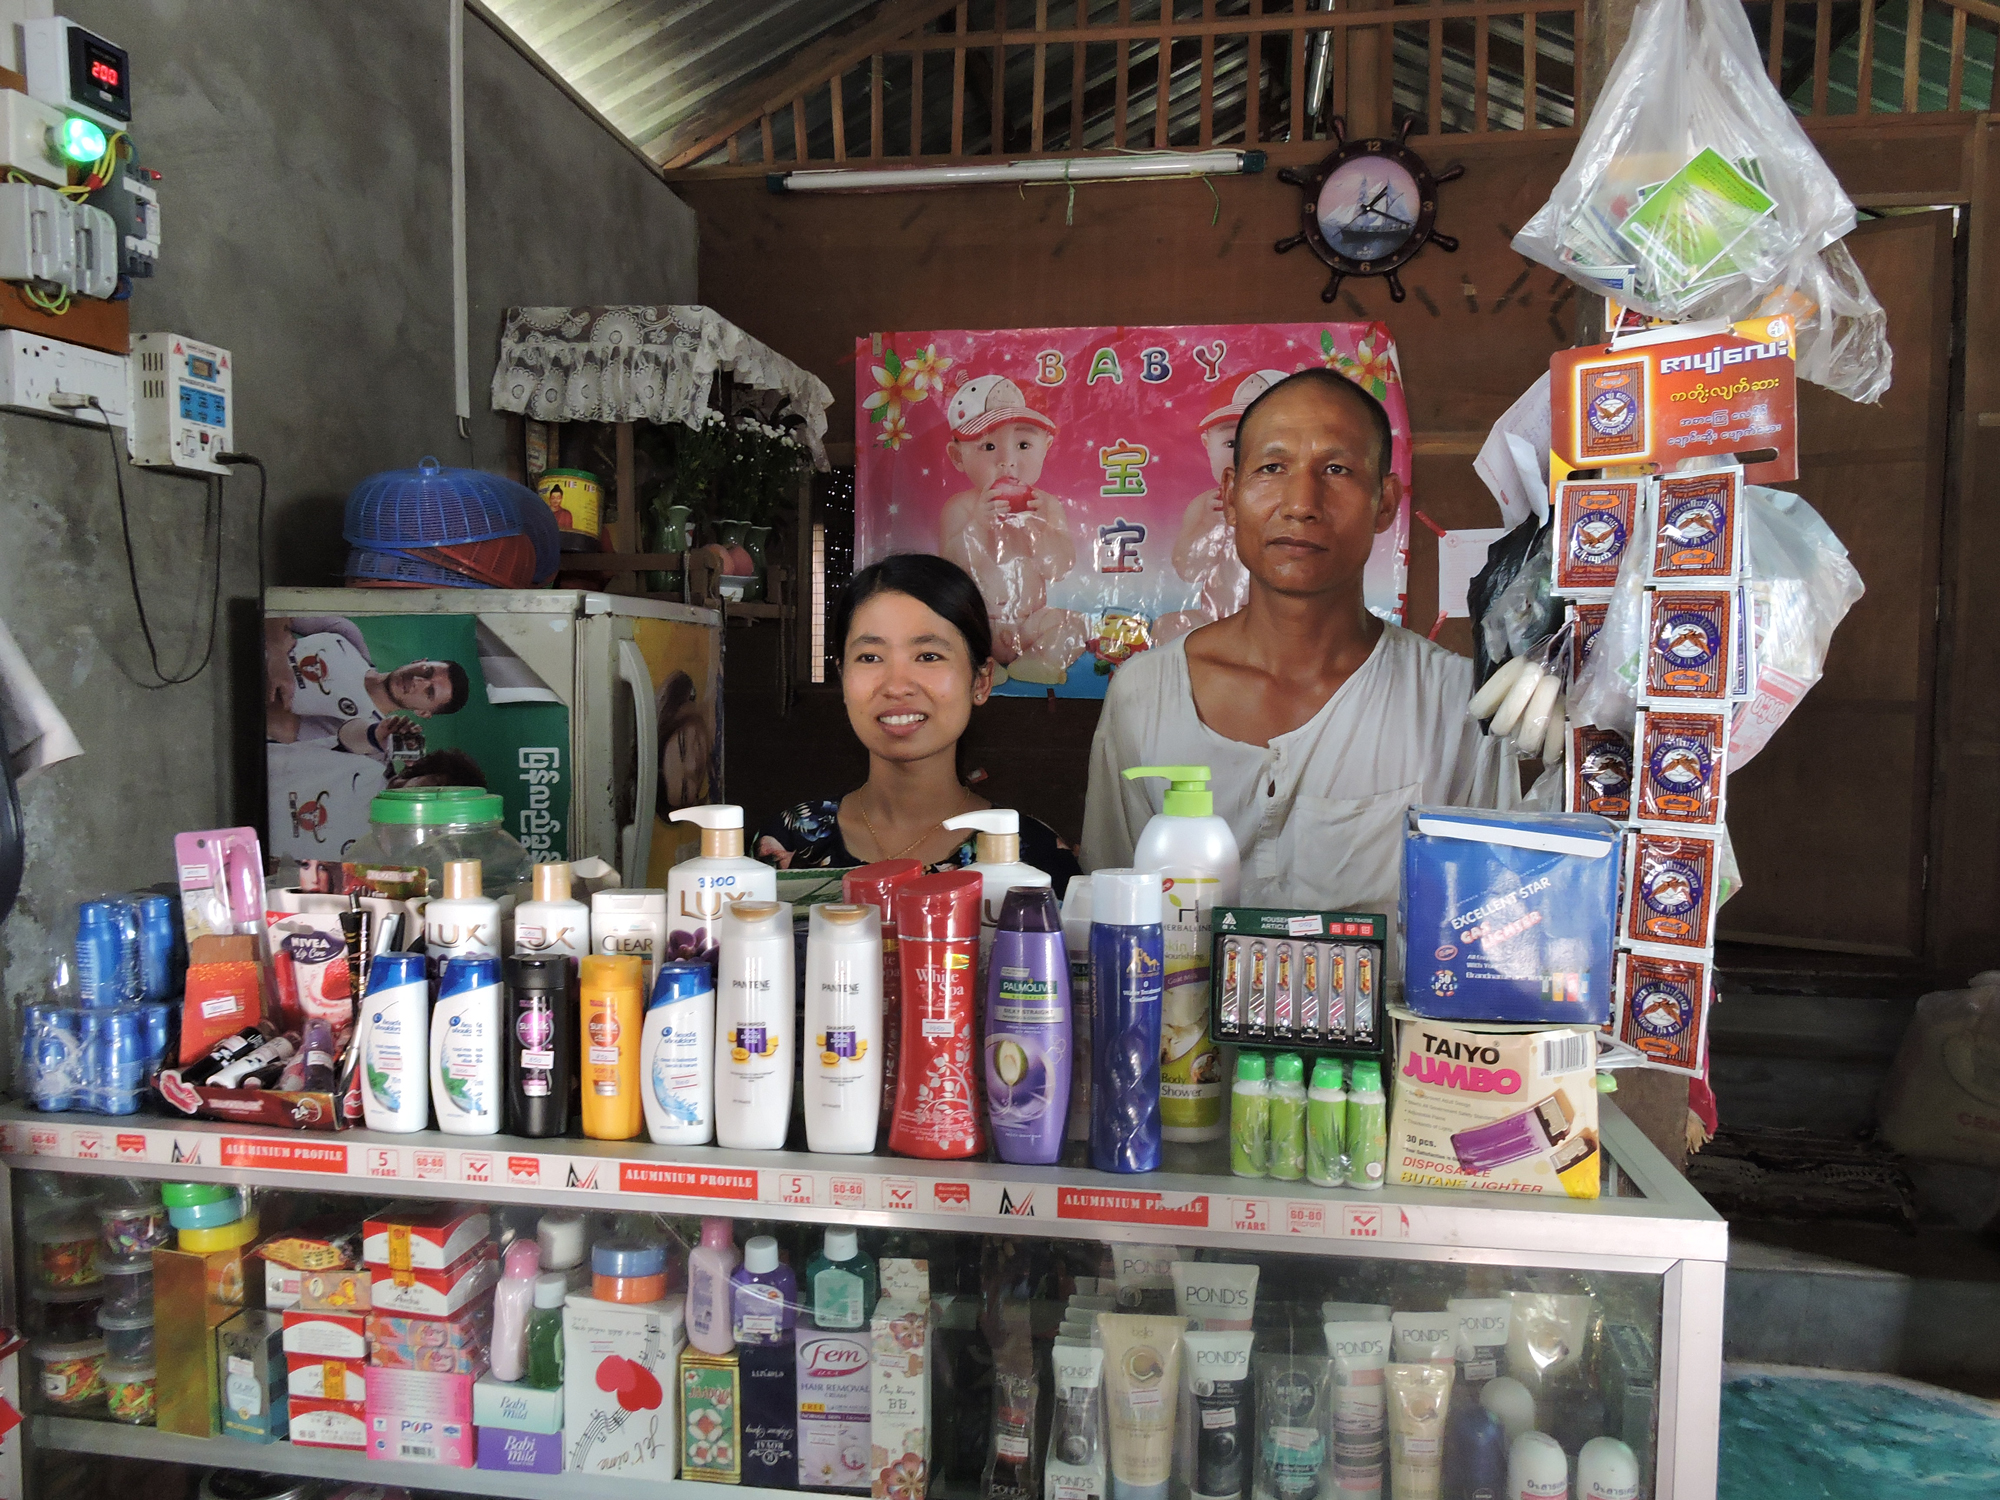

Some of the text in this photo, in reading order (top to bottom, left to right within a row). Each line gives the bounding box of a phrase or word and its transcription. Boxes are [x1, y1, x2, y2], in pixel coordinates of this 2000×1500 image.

[1366, 141, 1381, 151] 12
[1423, 201, 1434, 211] 3
[1360, 262, 1370, 272] 6
[1034, 340, 1228, 387] BABY
[1451, 891, 1518, 930] EXCELLENT
[1518, 877, 1552, 900] STAR
[427, 923, 488, 947] LUX
[1461, 921, 1491, 944] GAS
[1481, 910, 1542, 950] LIGHTER
[291, 937, 331, 948] NIVEA
[518, 928, 576, 950] UX
[602, 934, 654, 952] CLEAR
[308, 946, 326, 958] Care
[733, 979, 771, 988] PANTENE
[1438, 973, 1451, 984] 50
[822, 983, 859, 992] PANTENE
[938, 984, 965, 1000] Spa
[1022, 1008, 1055, 1016] STRAIGHT
[1422, 1033, 1500, 1065] TAIYO
[1162, 1073, 1186, 1086] Body
[1403, 1051, 1522, 1095] JUMBO
[1161, 1086, 1202, 1097] Shower
[1406, 1134, 1437, 1148] 30 pcs.
[225, 1143, 344, 1162] ALUMINIUM PROFILE
[379, 1152, 388, 1167] 5
[417, 1158, 443, 1167] 60-80
[625, 1169, 753, 1188] ALUMINIUM PROFILE
[792, 1178, 802, 1193] 5
[1400, 1171, 1543, 1193] BUTANE LIGHTER
[833, 1184, 862, 1194] 60-80
[783, 1194, 811, 1204] YEARS
[833, 1194, 862, 1202] micron
[1063, 1194, 1140, 1210] ALUMINIUM
[1245, 1203, 1256, 1219] 5
[1290, 1210, 1322, 1221] 60-80
[1235, 1220, 1266, 1231] YEARS
[1290, 1220, 1322, 1229] micron
[1123, 1259, 1171, 1274] POND
[1185, 1285, 1248, 1306] POND'S
[1459, 1316, 1505, 1330] POND'S
[1402, 1328, 1450, 1343] POND'S
[1336, 1340, 1383, 1354] POND'S
[806, 1344, 861, 1370] fem
[1196, 1350, 1246, 1365] POND'S
[1059, 1366, 1094, 1378] POND'S
[801, 1383, 823, 1391] HAIR
[826, 1384, 870, 1393] REMOVAL
[500, 1396, 528, 1409] Babi
[504, 1435, 535, 1451] Babi
[1051, 1474, 1094, 1490] POND'S
